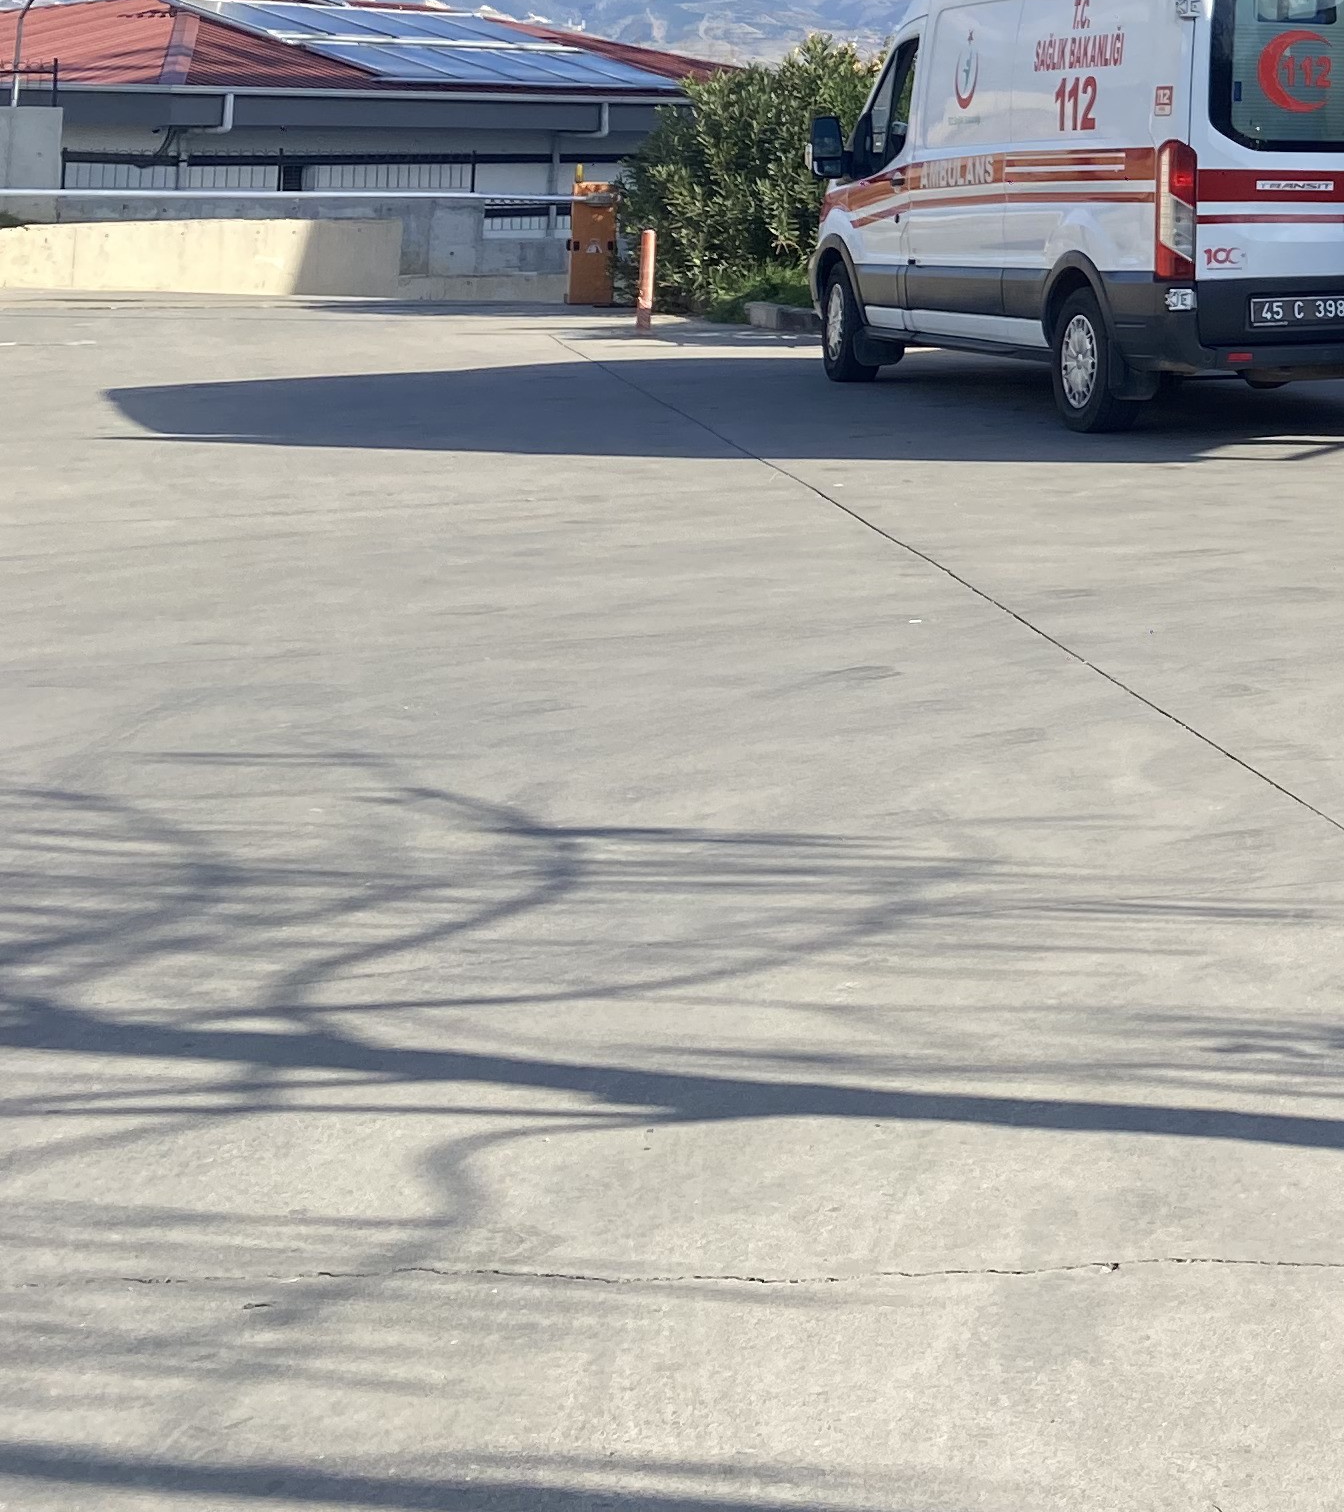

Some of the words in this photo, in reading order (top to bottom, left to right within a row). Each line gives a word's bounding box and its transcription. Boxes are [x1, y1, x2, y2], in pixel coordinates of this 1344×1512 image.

[1034, 33, 1068, 72] SAĞLIK
[1068, 25, 1125, 69] BAKANLIĞI
[1282, 55, 1333, 88] 112
[1055, 75, 1098, 131] 112
[920, 155, 994, 189] AMBULANS
[1258, 182, 1333, 190] TRANSIT
[1261, 302, 1284, 320] 45
[1293, 301, 1305, 319] C
